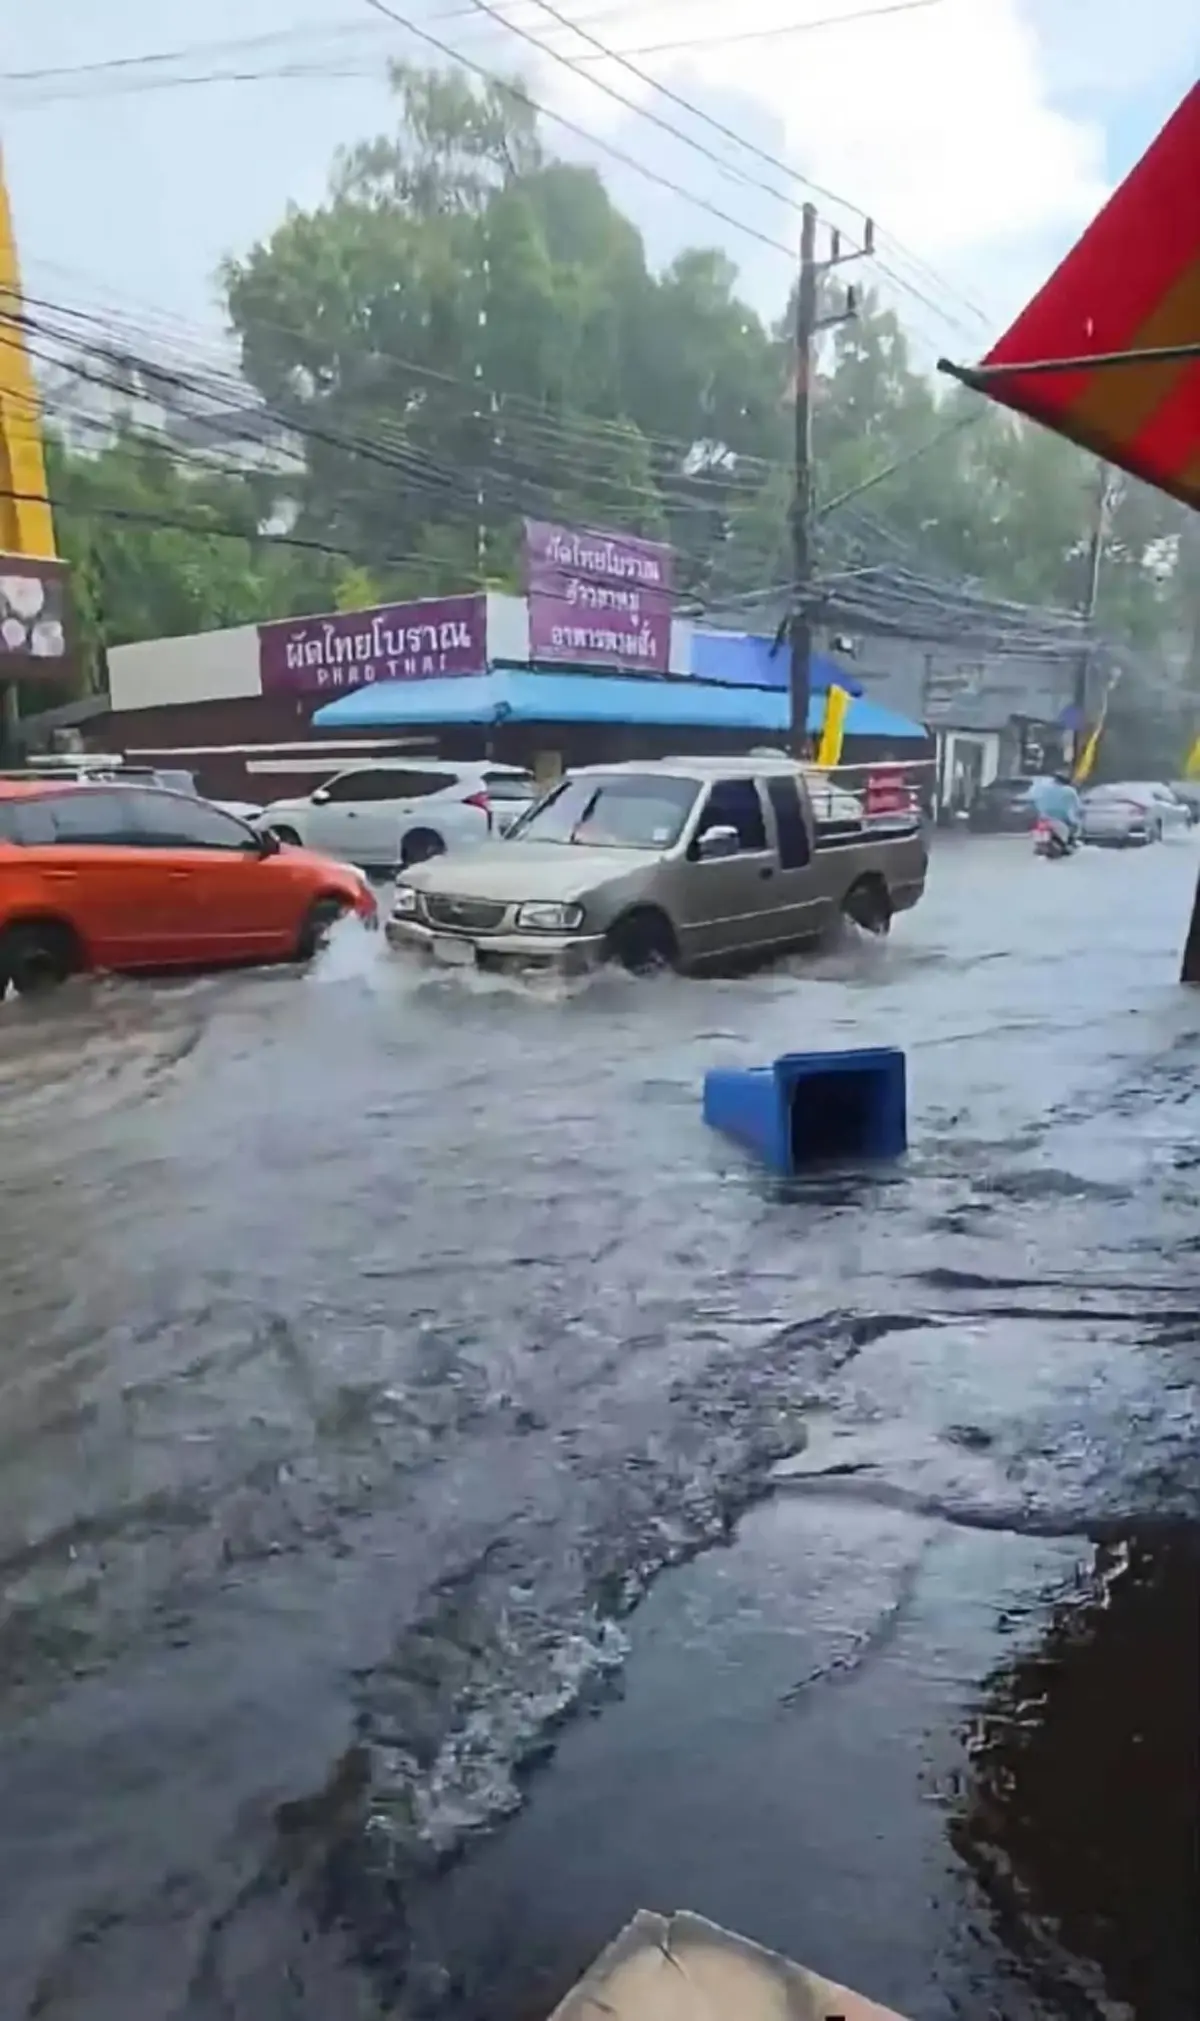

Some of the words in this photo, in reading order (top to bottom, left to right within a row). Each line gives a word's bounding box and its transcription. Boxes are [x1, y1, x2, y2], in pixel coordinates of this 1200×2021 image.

[286, 615, 471, 669] ผัดไทยโบราณ
[387, 654, 447, 677] THAI
